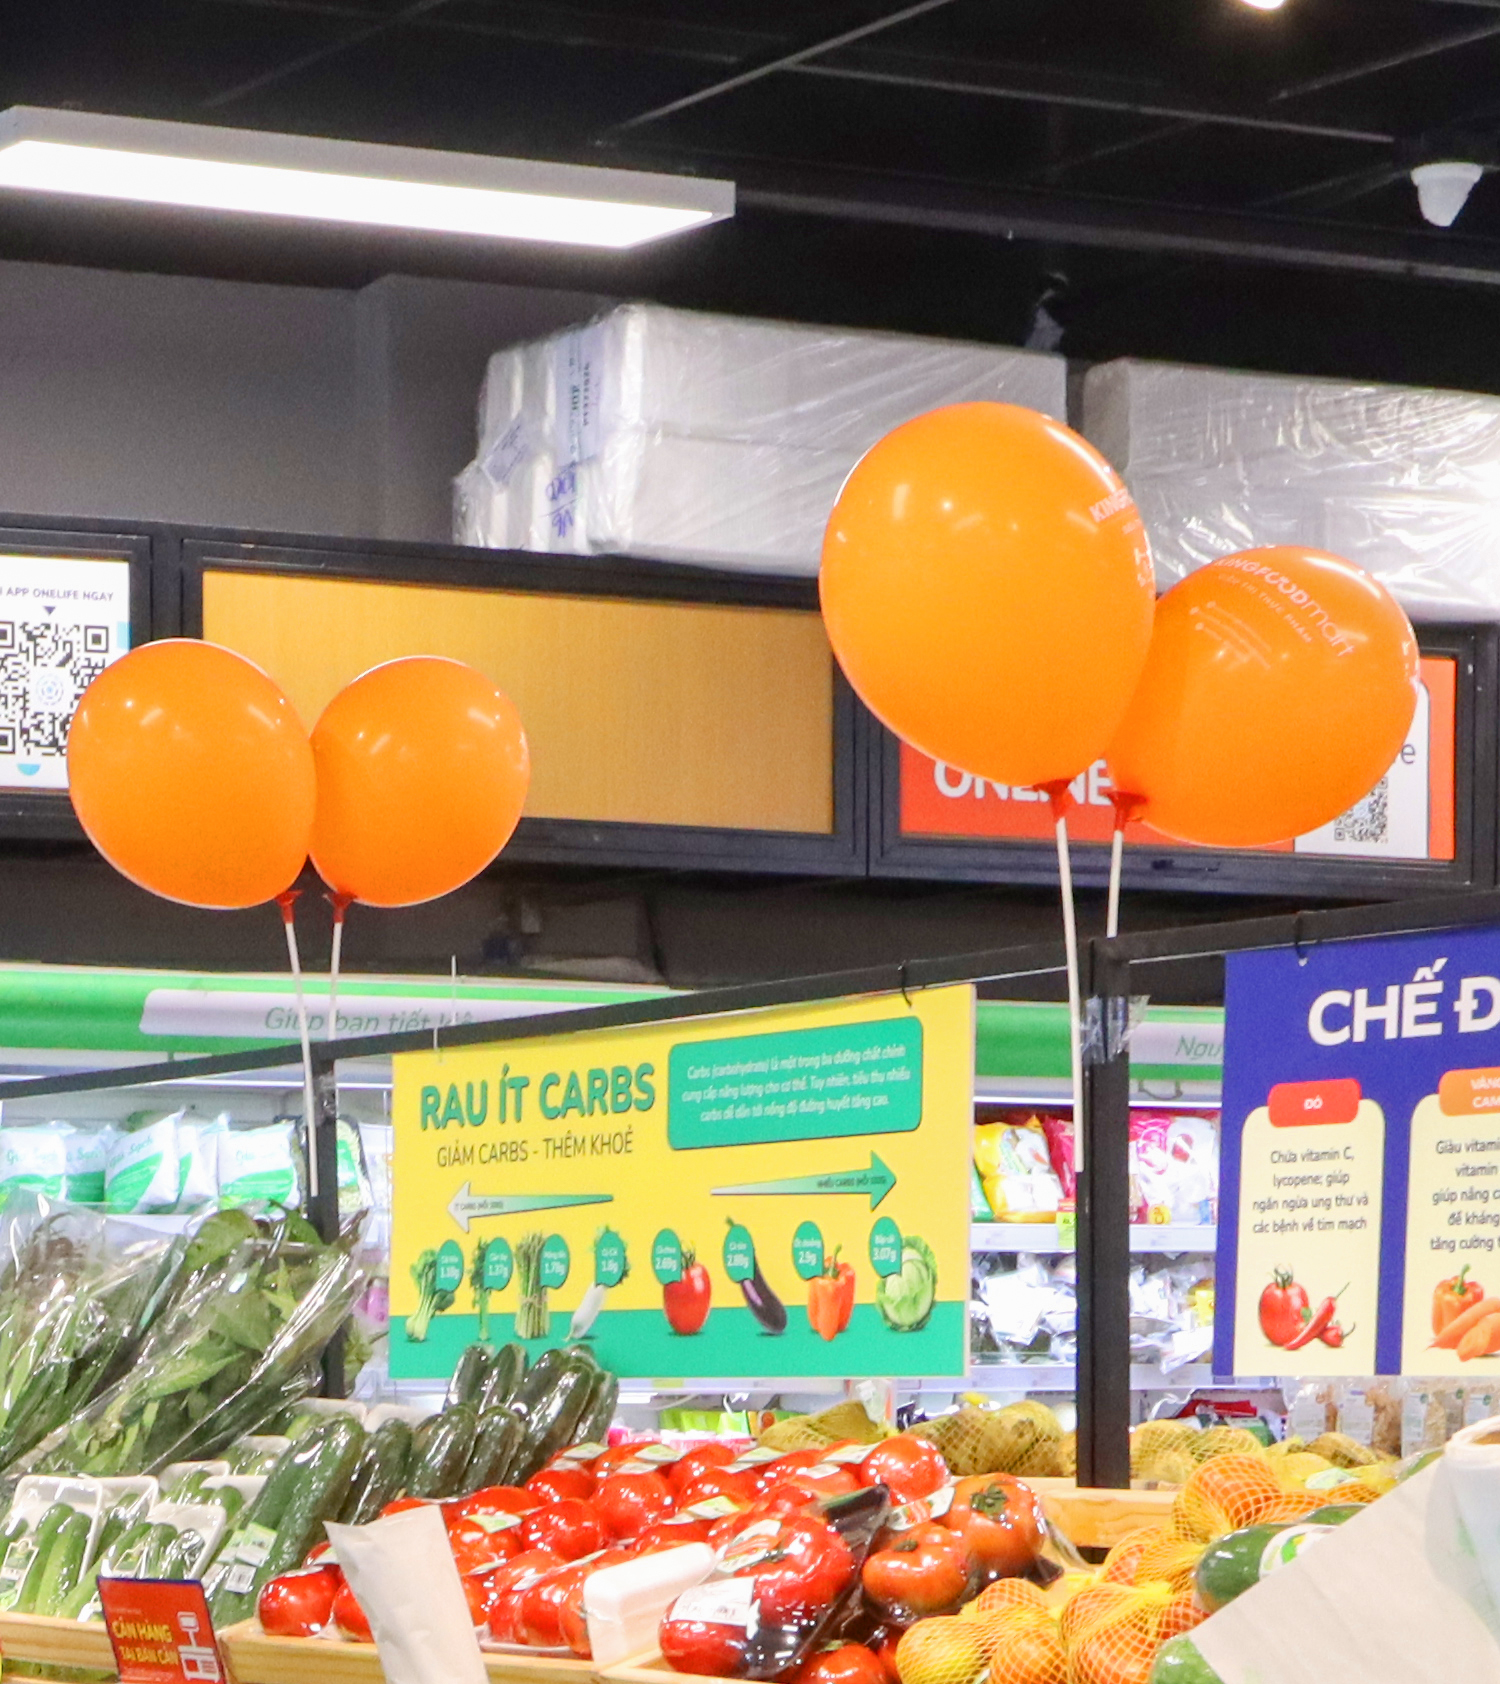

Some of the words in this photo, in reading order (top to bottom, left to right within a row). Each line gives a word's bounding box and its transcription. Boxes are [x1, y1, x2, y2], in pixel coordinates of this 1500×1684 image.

[334, 1009, 380, 1034] bạn
[1308, 957, 1448, 1046] CHẾ
[421, 1080, 489, 1131] RAU
[500, 1063, 530, 1124] ÍT
[539, 1062, 656, 1121] CARBS
[437, 1139, 474, 1167] GIẢM
[479, 1139, 528, 1164] CARBS
[543, 1130, 586, 1160] THÊM
[590, 1124, 634, 1155] KHOẺ
